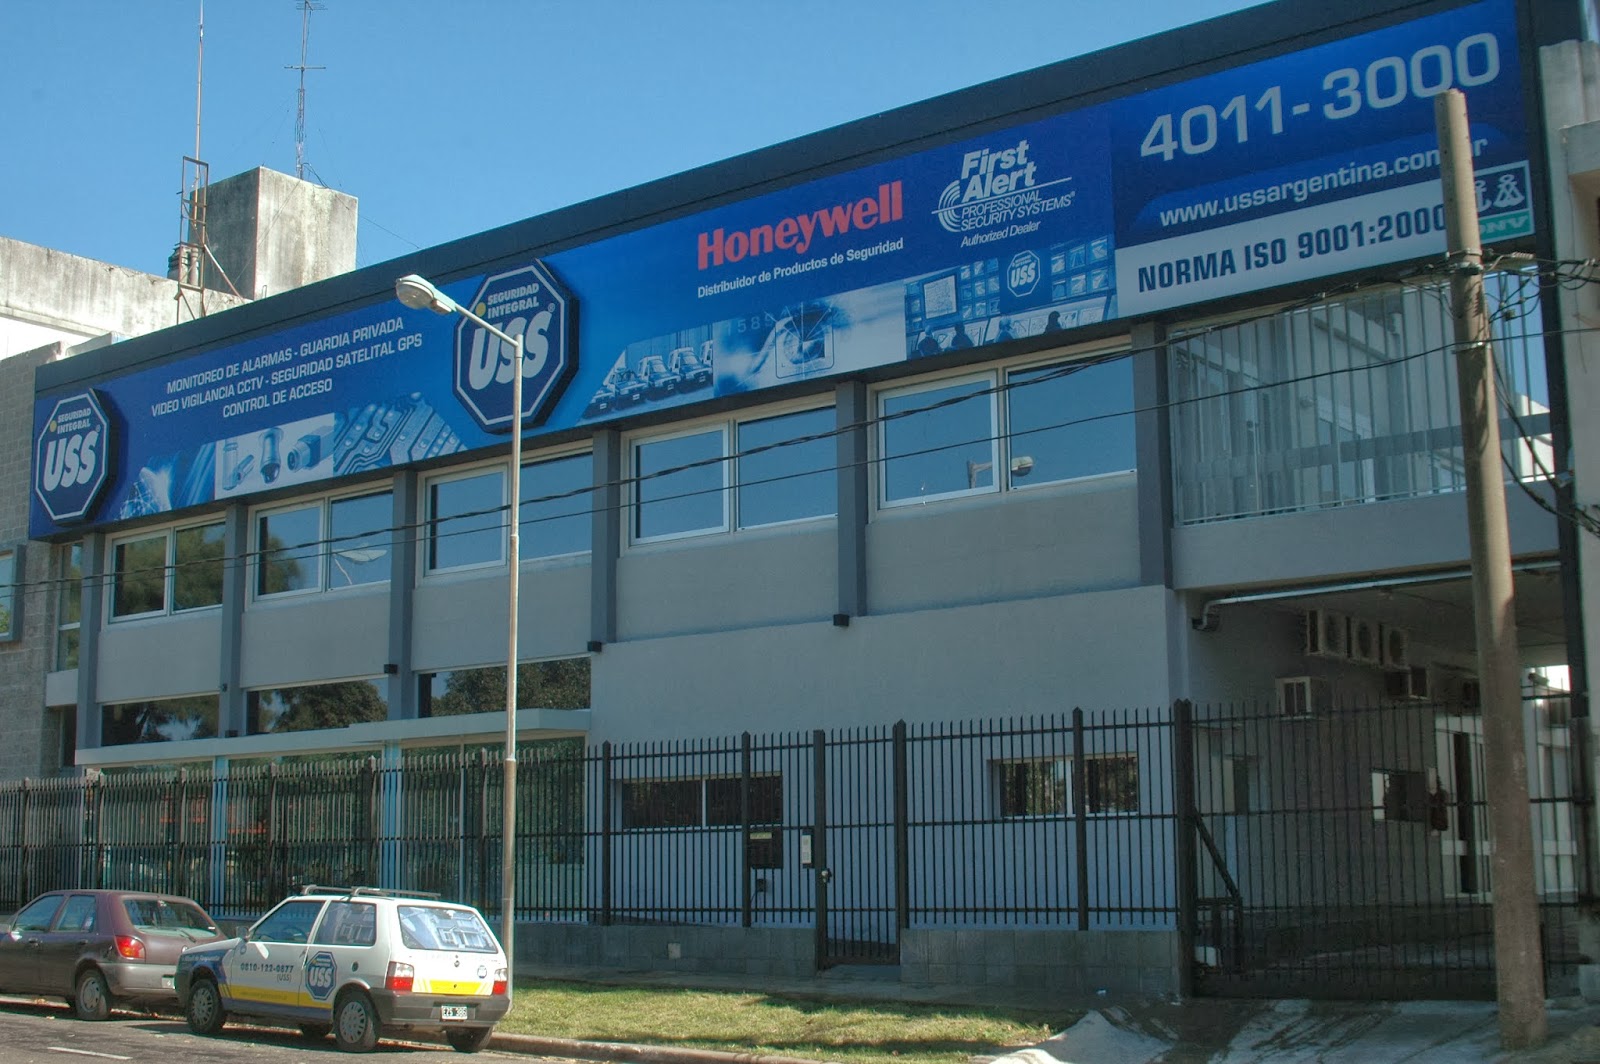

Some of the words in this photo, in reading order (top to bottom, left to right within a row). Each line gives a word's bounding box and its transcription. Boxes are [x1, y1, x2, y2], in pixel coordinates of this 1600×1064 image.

[961, 139, 1029, 179] First
[961, 161, 1037, 203] Alert
[1160, 137, 1488, 228] www.ussargentina.comr
[960, 209, 1017, 232] SECURITY
[1017, 194, 1072, 218] SYSTEMS
[962, 190, 1042, 219] PROFESSIONAL
[697, 180, 903, 271] Honeywell
[960, 225, 1009, 248] Authorized
[1009, 220, 1041, 237] Dealer
[697, 275, 757, 298] Distribuidor
[758, 271, 771, 283] de
[773, 258, 828, 280] Productos
[830, 253, 844, 265] de
[846, 237, 904, 262] Seguridad
[1138, 249, 1236, 293] NORMA
[1244, 238, 1286, 271] ISO
[1298, 203, 1446, 259] 9001:2000
[487, 283, 540, 304] SEGURIDAD
[1011, 262, 1036, 288] USS
[487, 296, 540, 319] INTEGRAL
[167, 368, 224, 394] MONITOREO
[226, 363, 240, 379] DE
[241, 348, 293, 373] ALARMAS
[300, 332, 350, 357] GUARDIA
[352, 317, 404, 344] PRIVADA
[468, 310, 552, 391] USS
[151, 399, 179, 417] VIDEO
[181, 384, 235, 409] VIGILANCIA
[237, 376, 264, 394] CCTV
[271, 358, 333, 385] SEGURIDAD
[336, 343, 395, 368] SATELITAL
[398, 333, 422, 351] GPS
[57, 408, 92, 423] SEGURIDAD
[223, 396, 270, 418] CONTROL
[272, 391, 286, 405] DE
[289, 378, 332, 401] ACCESO
[57, 419, 92, 434] INTEGRAL
[43, 430, 99, 491] USS
[310, 967, 333, 988] USS
